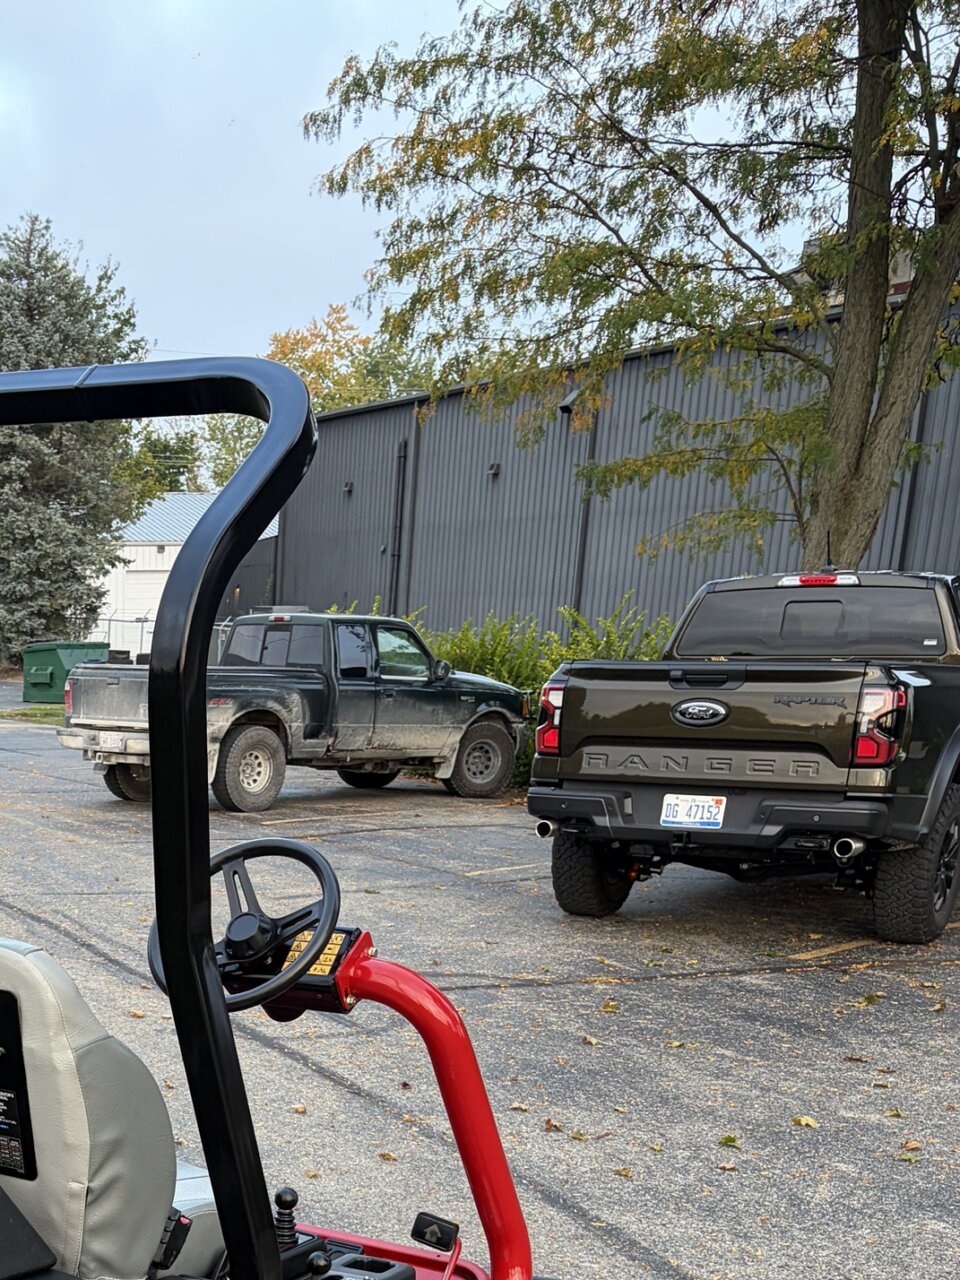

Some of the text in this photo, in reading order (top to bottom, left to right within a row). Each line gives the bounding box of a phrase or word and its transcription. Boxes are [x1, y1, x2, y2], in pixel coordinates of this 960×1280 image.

[773, 695, 847, 710] RAPTOR
[685, 706, 714, 719] Ford
[583, 752, 820, 777] RANGER
[665, 803, 721, 821] DG 47152
